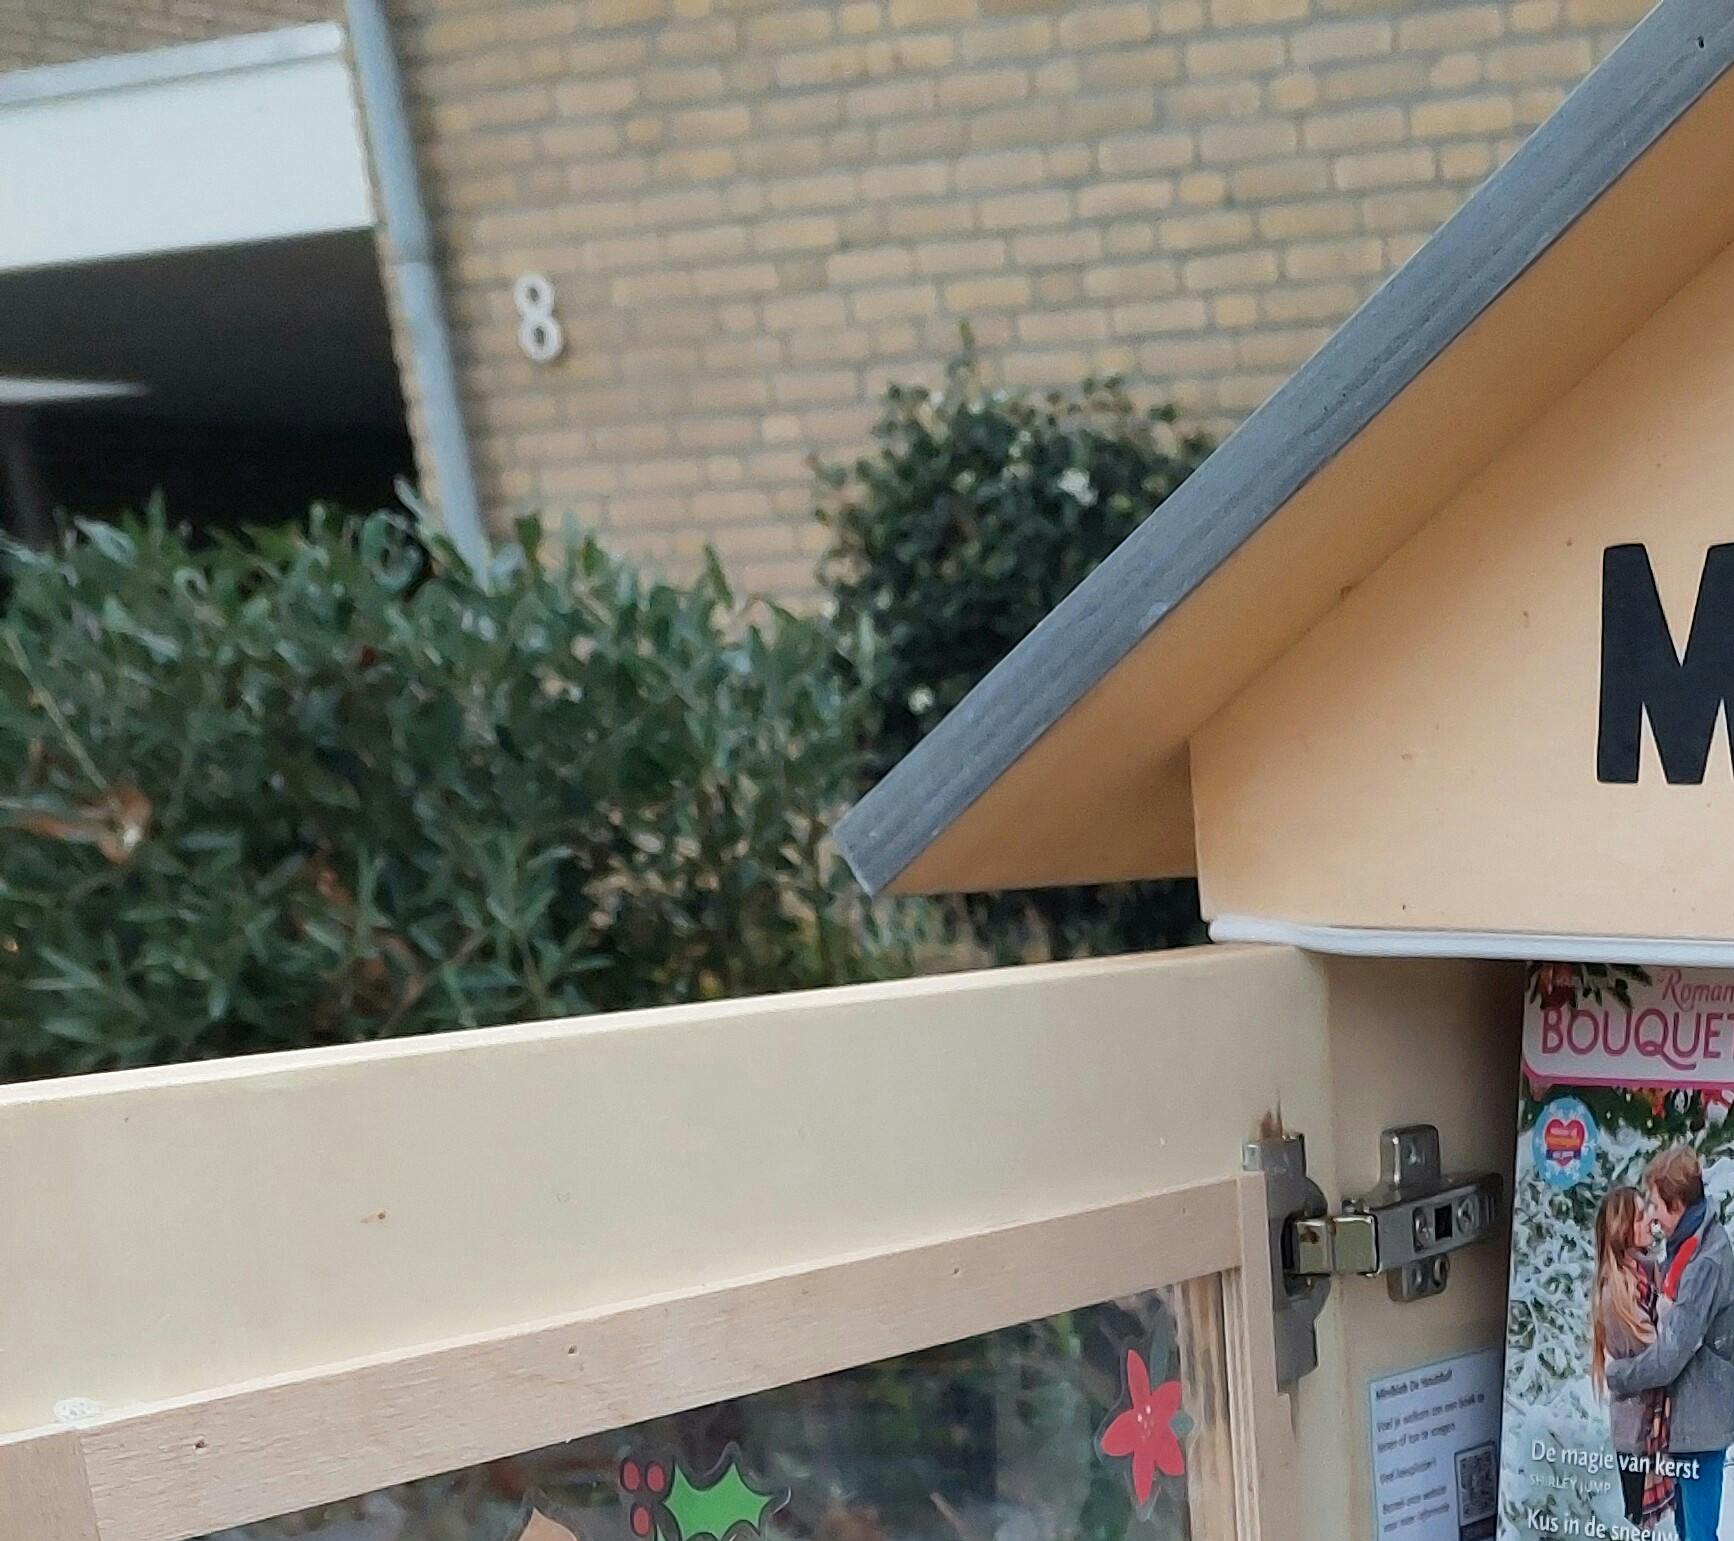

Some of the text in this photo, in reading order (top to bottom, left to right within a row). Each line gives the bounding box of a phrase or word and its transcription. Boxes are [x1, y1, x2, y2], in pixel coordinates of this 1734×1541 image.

[514, 273, 562, 363] 8
[1531, 1440, 1700, 1479] De magie van kerst
[1528, 1509, 1558, 1531] Kus
[1564, 1516, 1579, 1535] in
[1585, 1515, 1606, 1539] de
